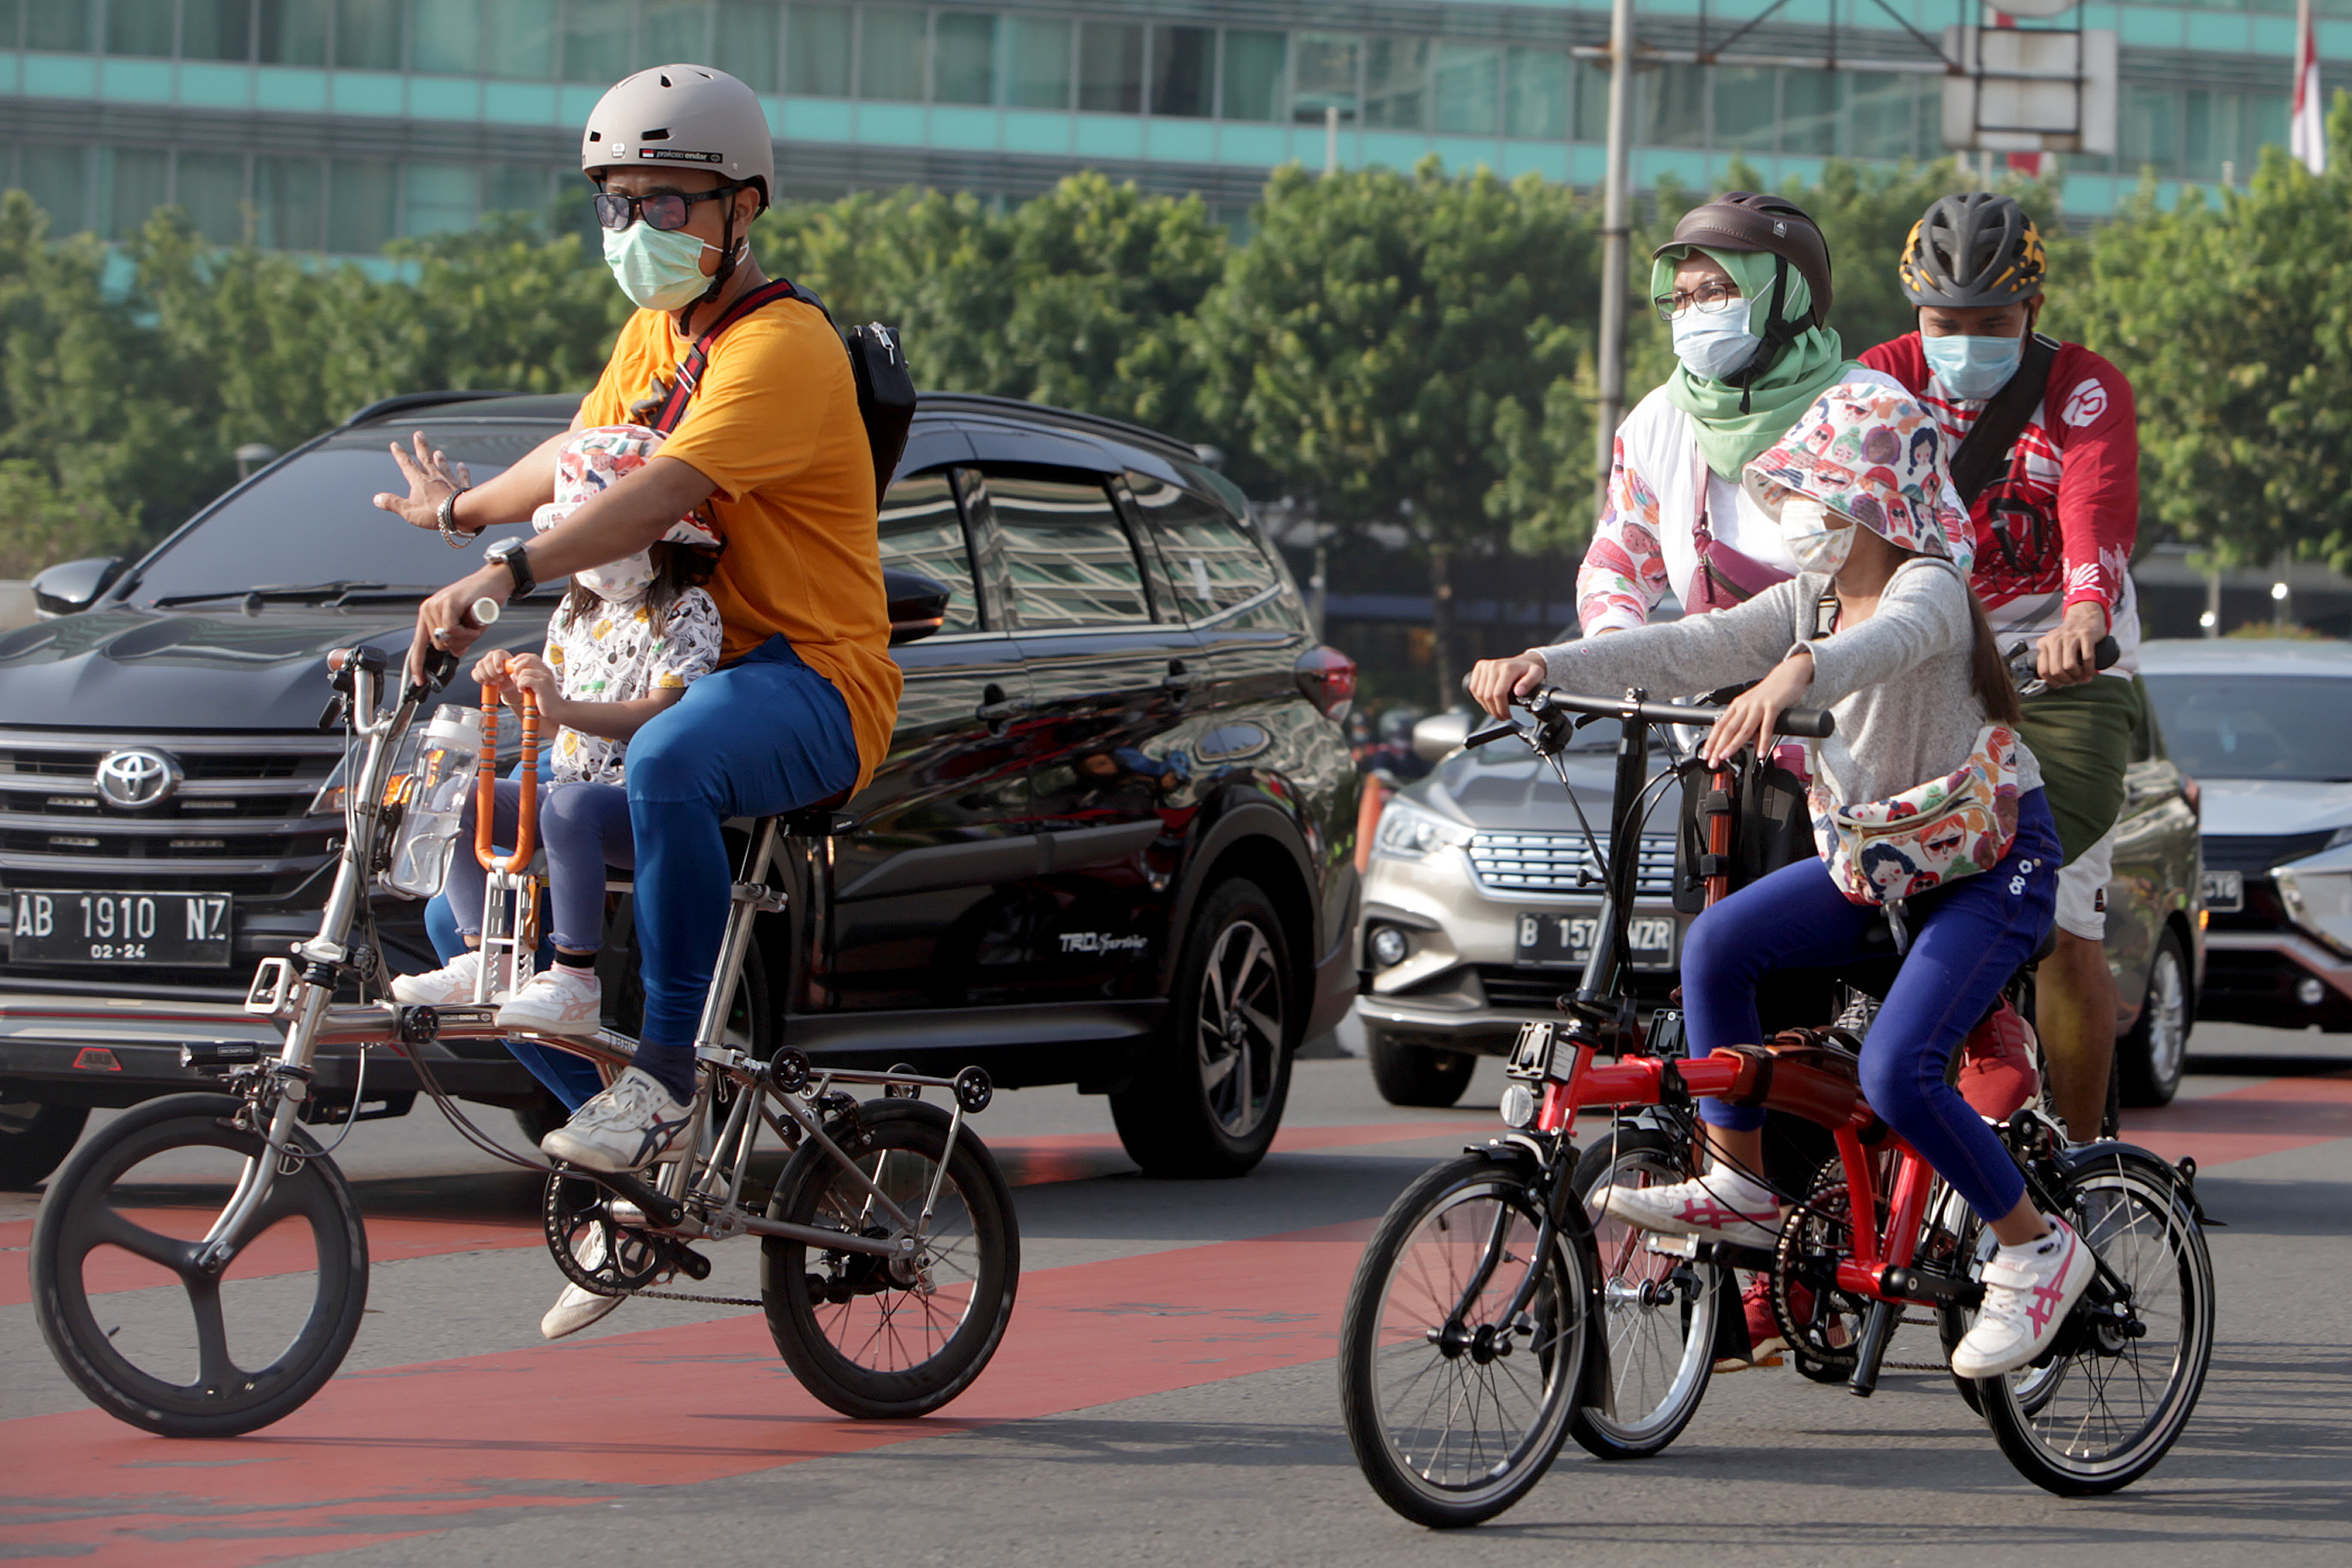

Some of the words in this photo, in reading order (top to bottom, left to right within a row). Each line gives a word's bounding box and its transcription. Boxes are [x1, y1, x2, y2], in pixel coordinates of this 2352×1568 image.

[684, 152, 708, 161] endar
[15, 895, 54, 937] AB
[80, 896, 155, 939] 1910
[186, 898, 226, 940] NZ
[1520, 918, 1538, 947] B
[1560, 918, 1598, 948] 157
